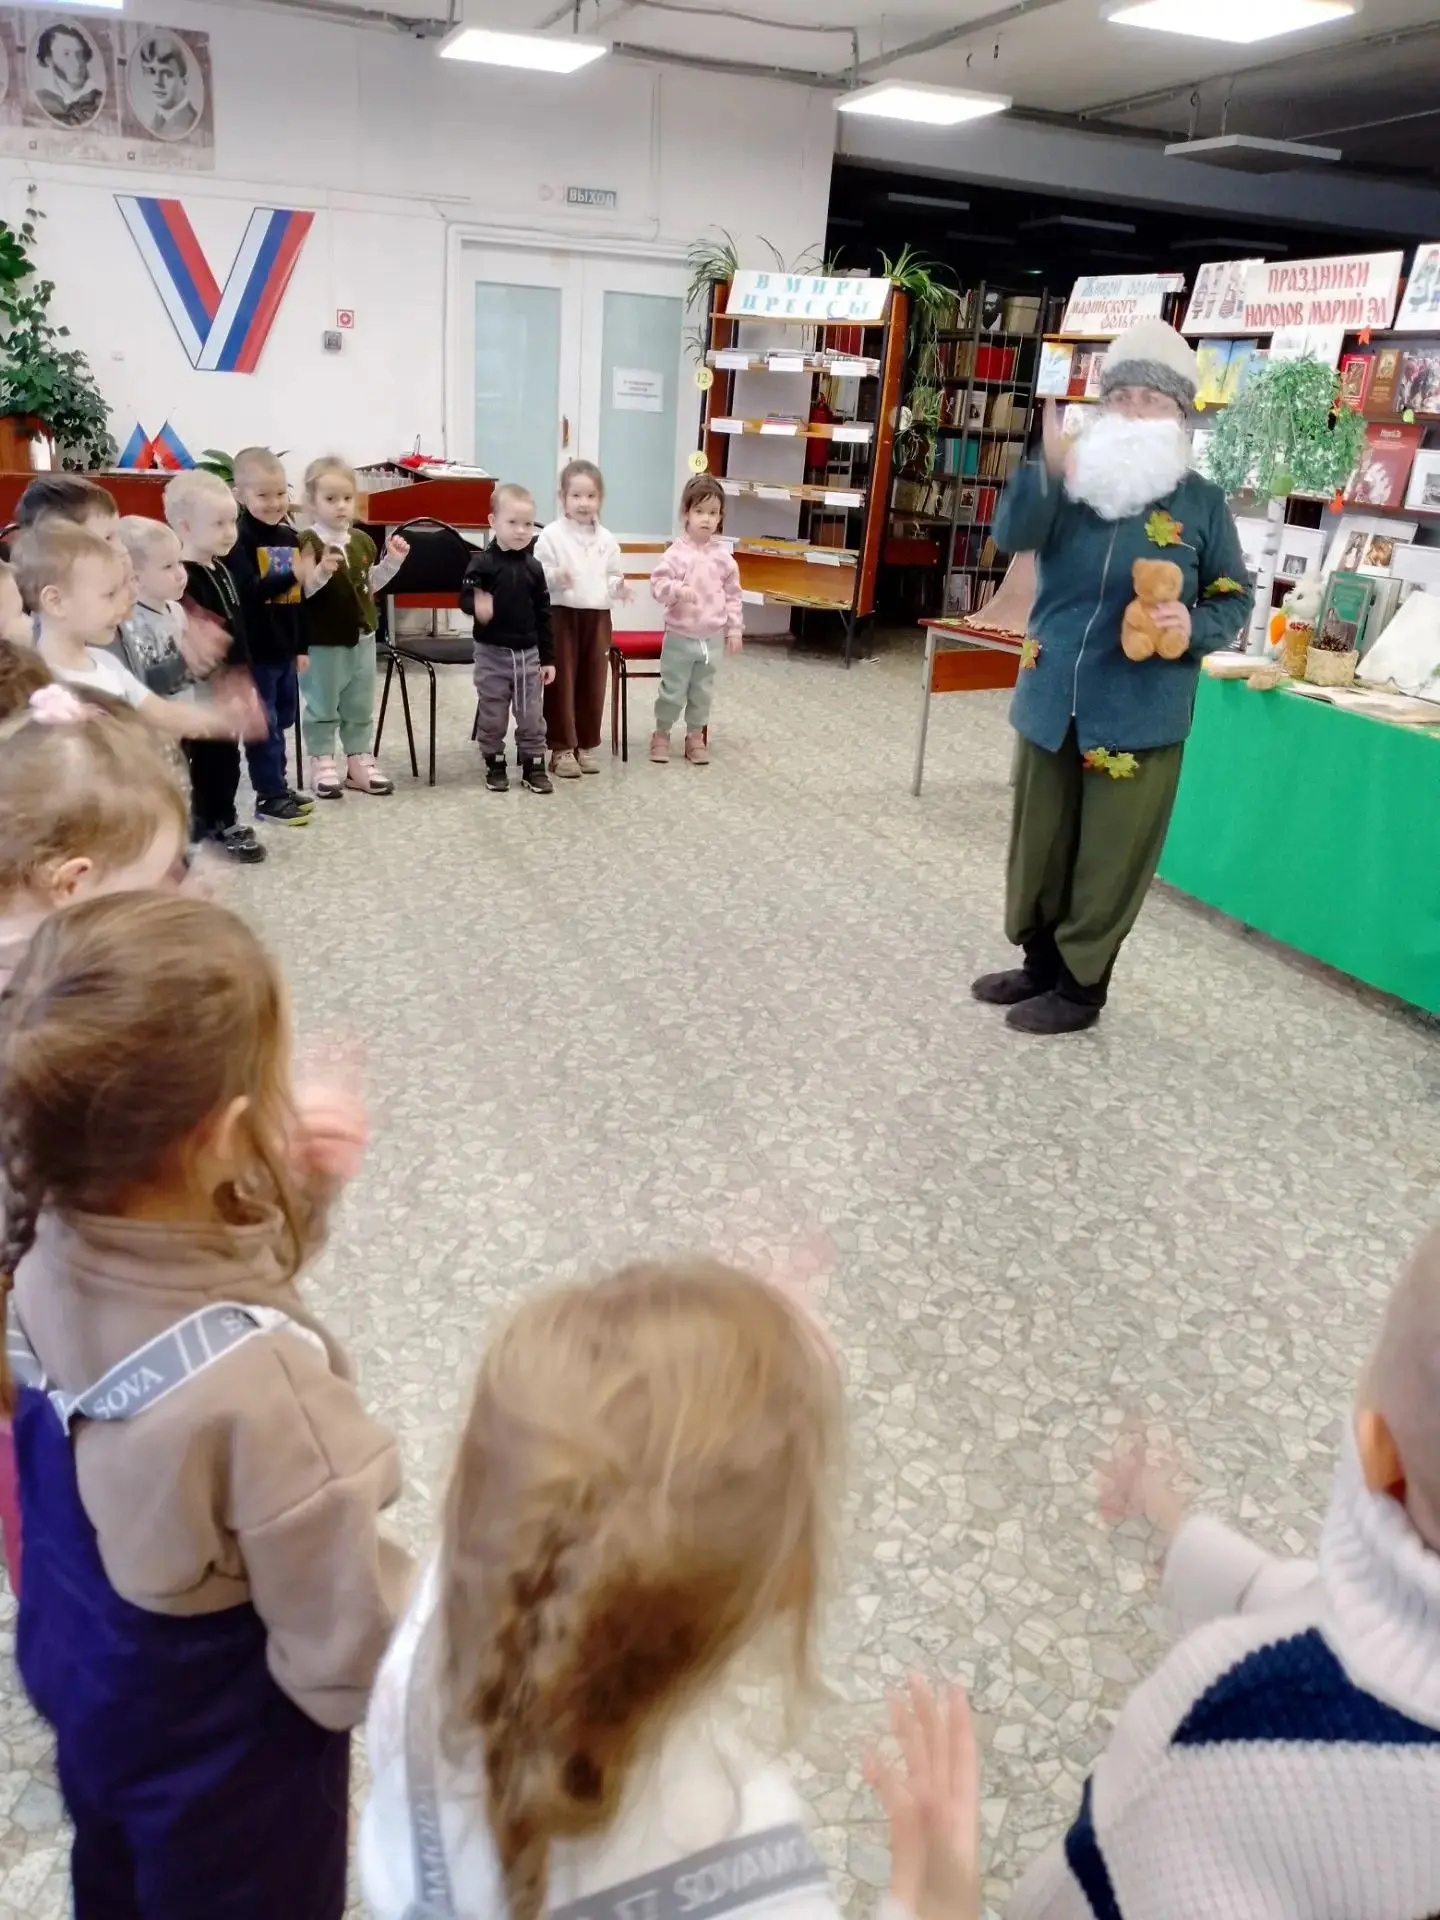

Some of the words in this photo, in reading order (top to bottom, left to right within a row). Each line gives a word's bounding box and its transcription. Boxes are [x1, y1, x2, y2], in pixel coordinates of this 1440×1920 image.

[569, 188, 615, 209] ВЫХОД
[755, 273, 771, 290] В
[1267, 262, 1371, 294] ПРАЗДНИКИ
[1244, 301, 1304, 329] НАРОДОВ
[1307, 292, 1365, 326] МАРИЙ
[92, 1364, 165, 1419] SOVA
